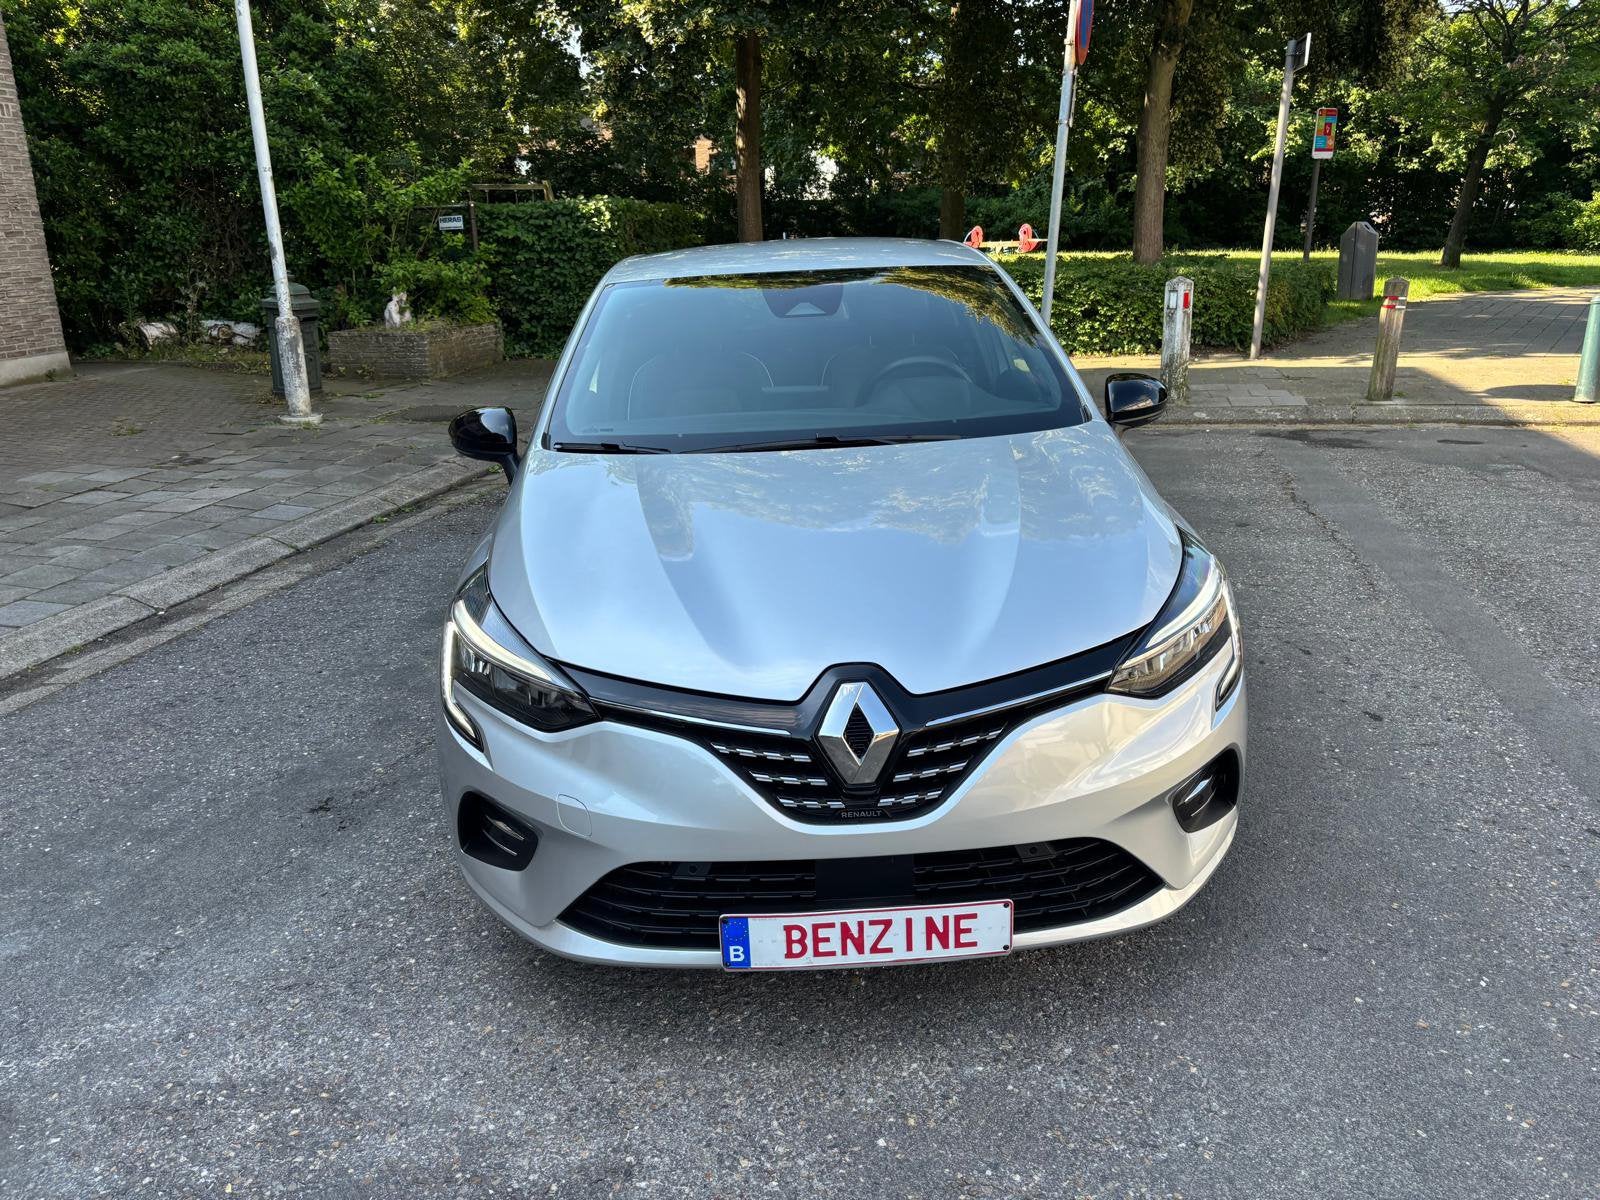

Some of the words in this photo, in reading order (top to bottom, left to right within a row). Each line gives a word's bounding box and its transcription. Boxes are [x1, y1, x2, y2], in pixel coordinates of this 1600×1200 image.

[841, 810, 882, 818] RENAULT
[783, 913, 978, 960] BENZINE
[729, 945, 745, 962] B
